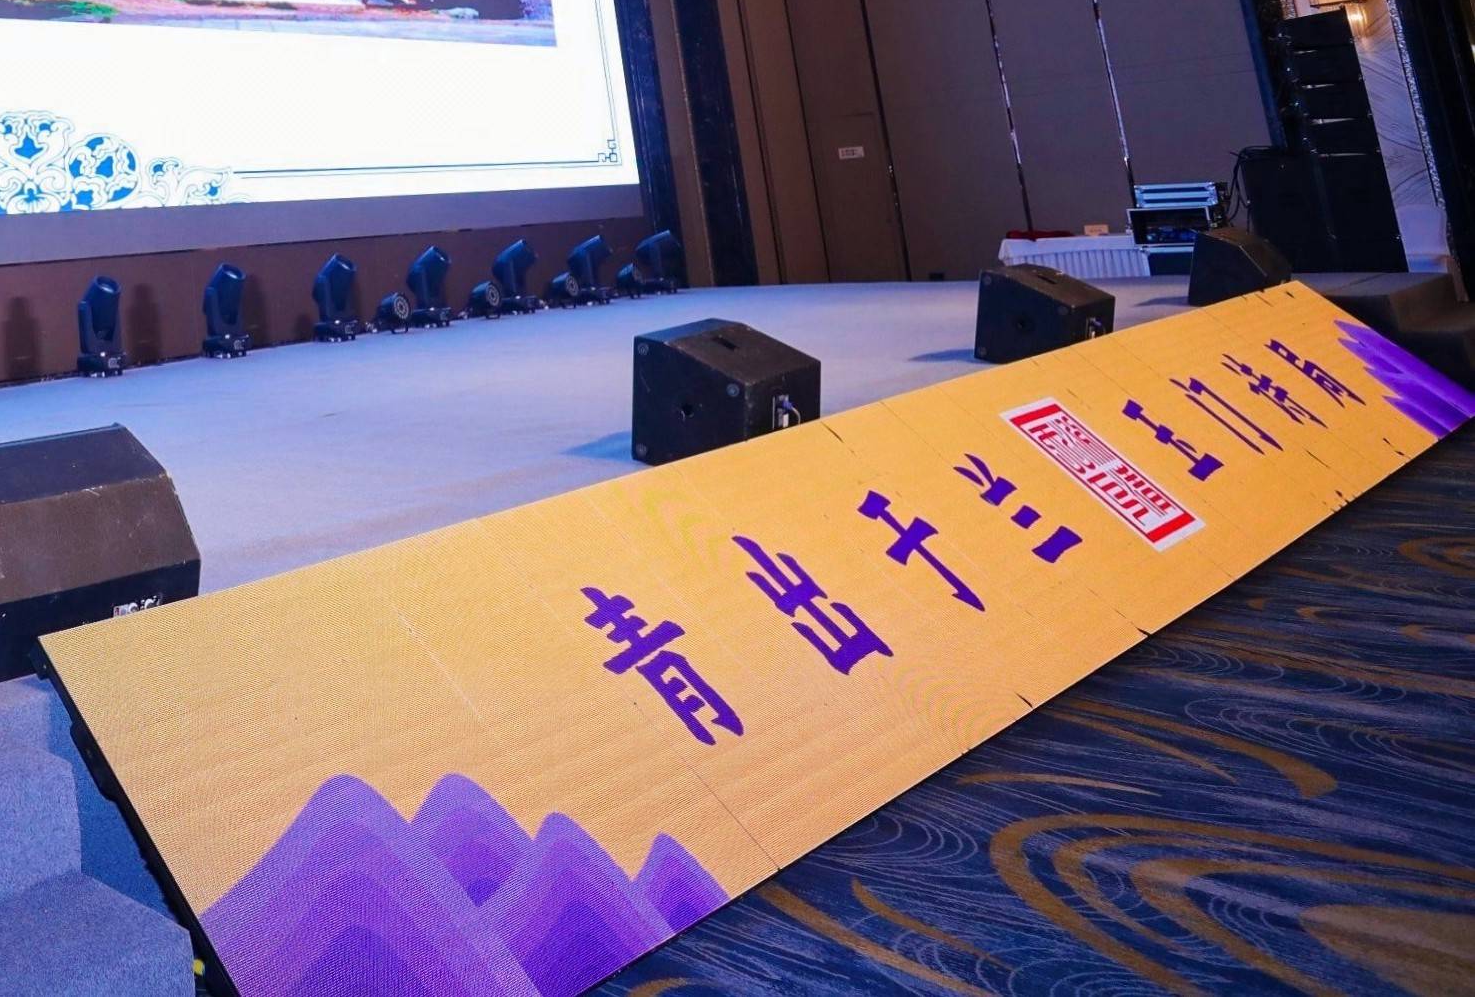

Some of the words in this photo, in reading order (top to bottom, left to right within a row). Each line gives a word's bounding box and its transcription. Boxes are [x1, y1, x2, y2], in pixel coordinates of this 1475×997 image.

[581, 453, 1083, 746] 青出于兰
[1122, 339, 1366, 481] 玉门诗局
